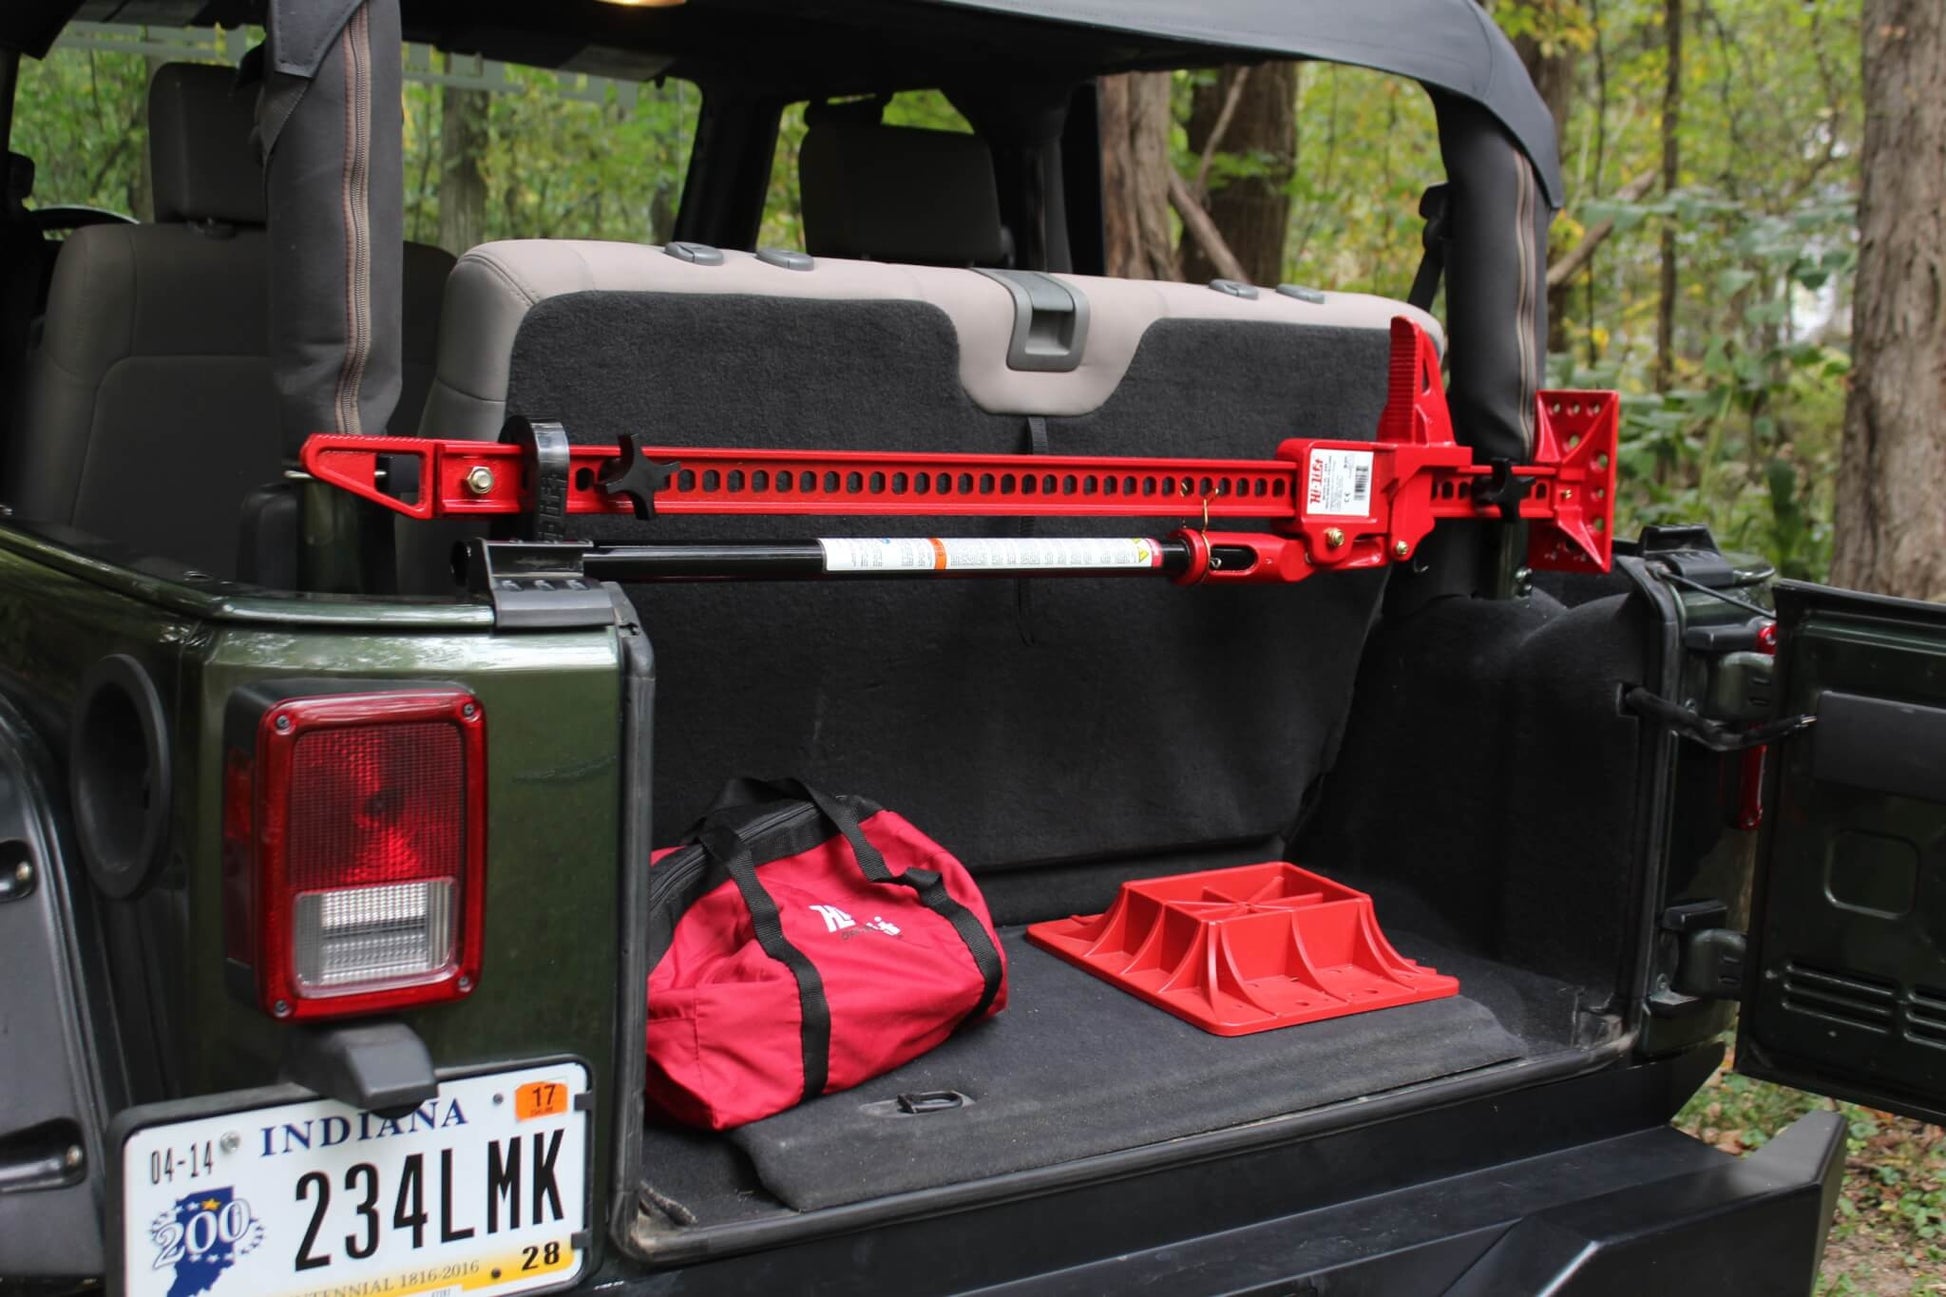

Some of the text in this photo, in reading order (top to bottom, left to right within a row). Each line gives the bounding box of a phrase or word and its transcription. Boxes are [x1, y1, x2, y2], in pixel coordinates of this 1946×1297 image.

[532, 1083, 556, 1108] 17
[260, 1098, 468, 1157] INDIANA
[150, 1140, 213, 1185] 04-14
[295, 1128, 565, 1272] 234LMK
[152, 1198, 252, 1271] 200
[522, 1241, 560, 1271] 28
[400, 1260, 480, 1288] 1816-2016
